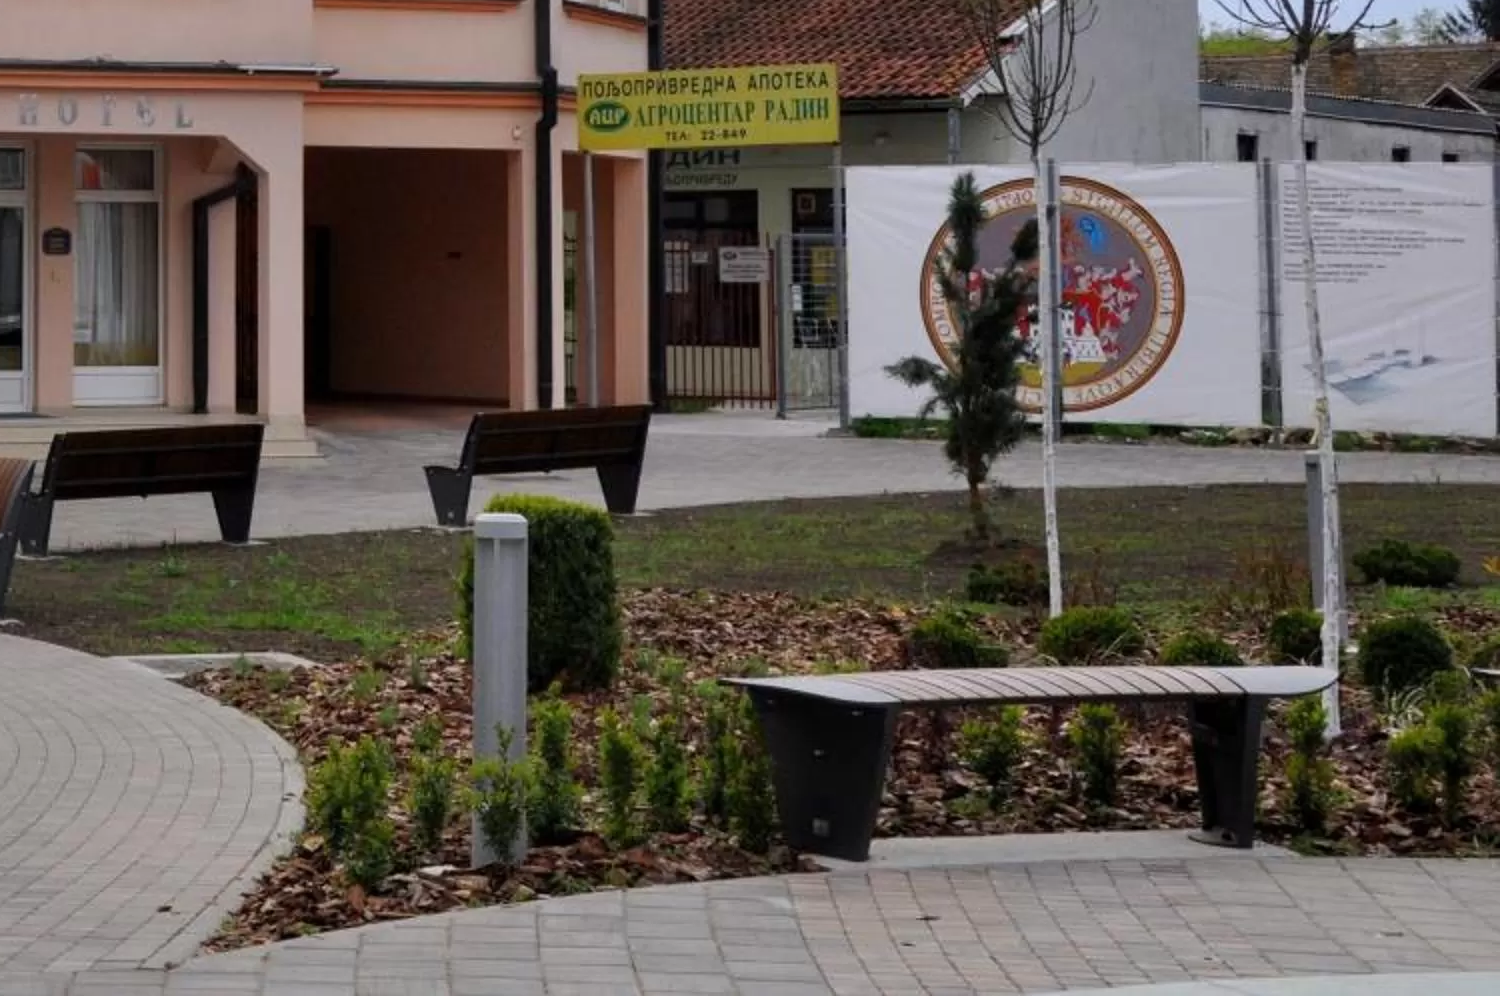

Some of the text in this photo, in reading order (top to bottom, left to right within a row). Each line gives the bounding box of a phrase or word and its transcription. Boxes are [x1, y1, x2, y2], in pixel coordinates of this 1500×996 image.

[583, 70, 829, 99] ПОЉОПРИВРЕДНА АПОТЕКА
[18, 92, 194, 129] HOTEL
[633, 97, 830, 129] АГРОЦЕНТАР РАДИН
